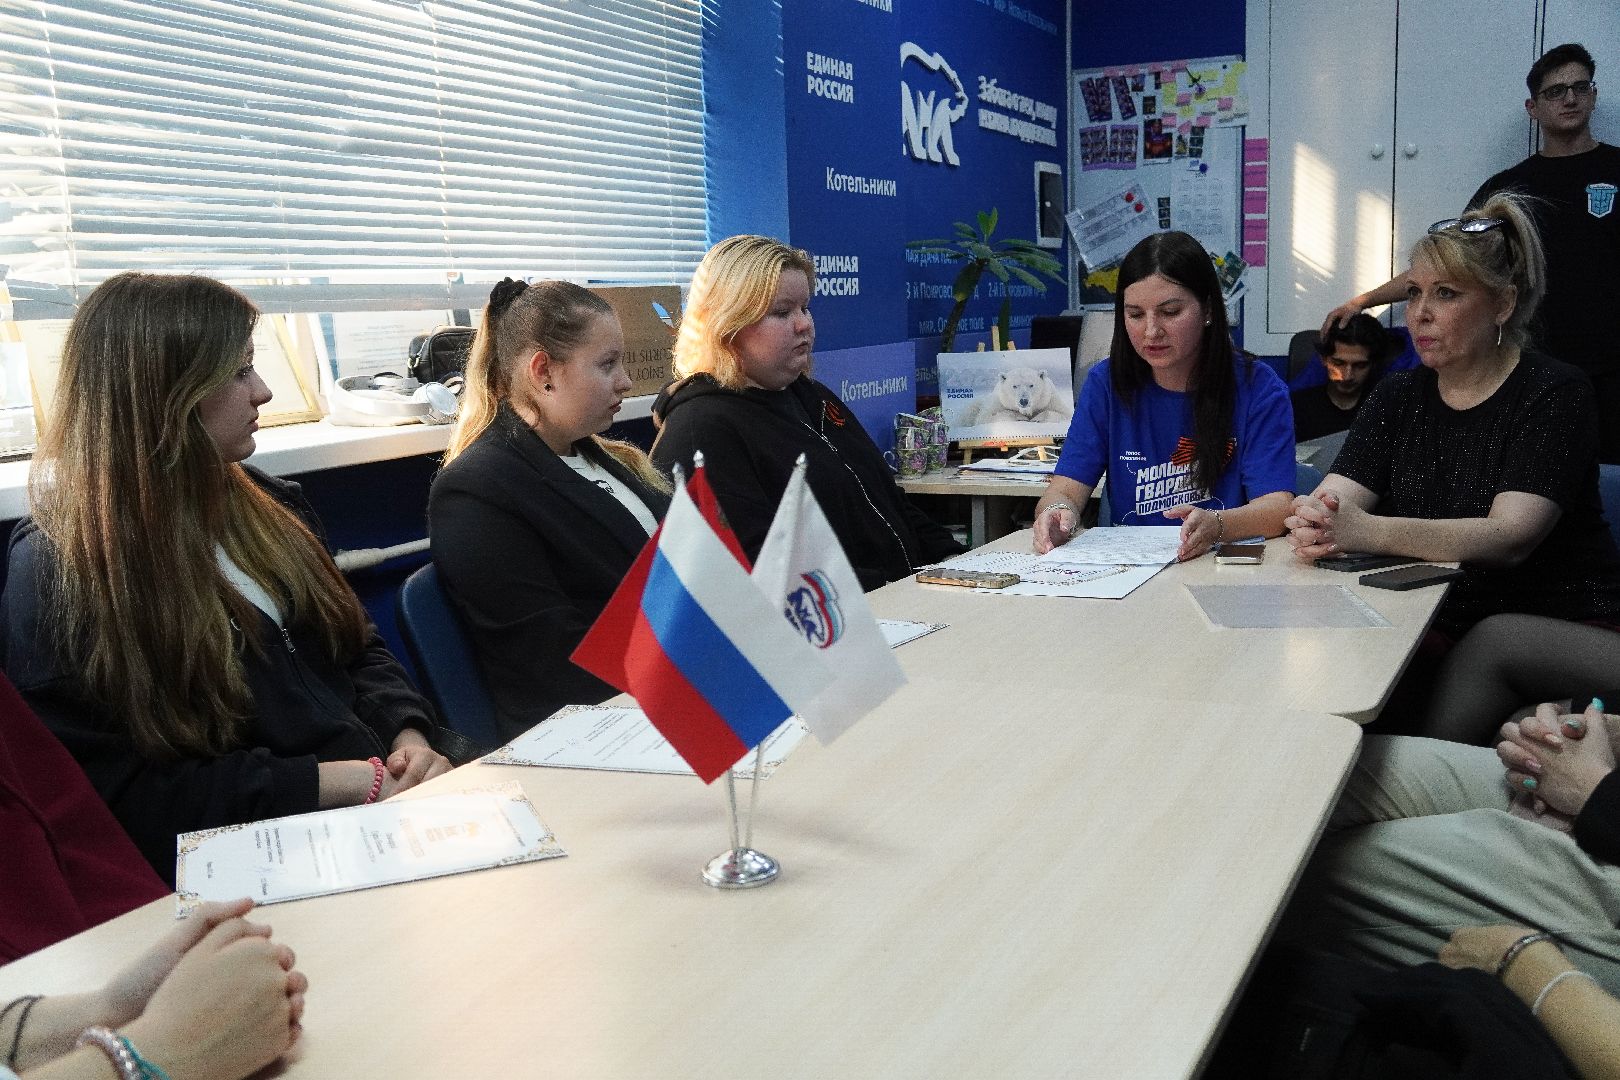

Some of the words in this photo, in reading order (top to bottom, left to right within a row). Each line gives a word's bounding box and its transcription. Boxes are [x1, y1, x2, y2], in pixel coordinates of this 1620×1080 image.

[806, 51, 854, 81] ЕДИНАЯ
[807, 74, 854, 104] РОССИЯ
[826, 166, 897, 197] Котельники
[813, 255, 859, 275] ЕДИНАЯ
[814, 277, 860, 297] РОССИЯ
[841, 375, 908, 403] Котельники
[1136, 474, 1198, 502] ГВАРДИ
